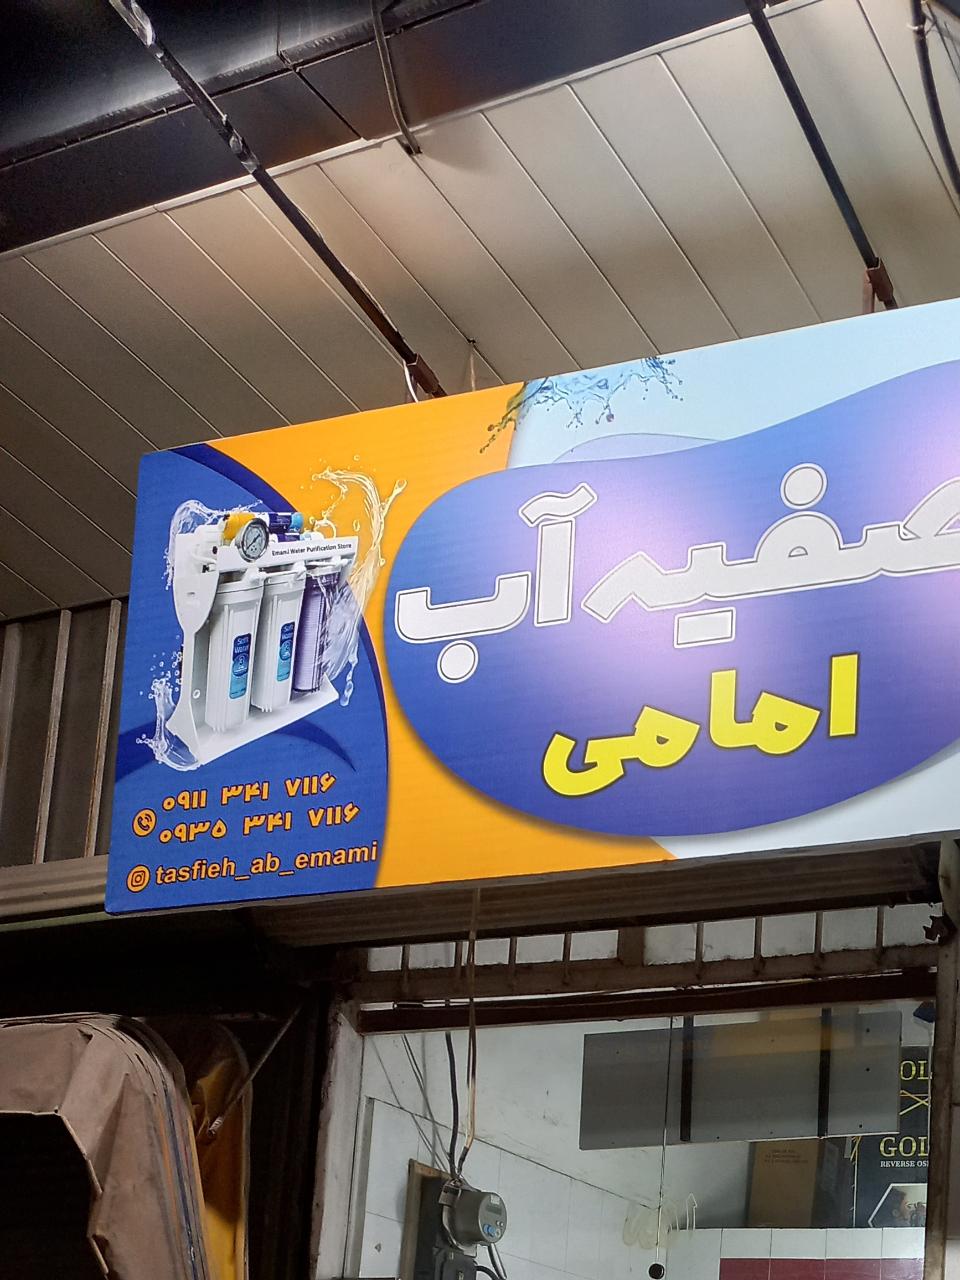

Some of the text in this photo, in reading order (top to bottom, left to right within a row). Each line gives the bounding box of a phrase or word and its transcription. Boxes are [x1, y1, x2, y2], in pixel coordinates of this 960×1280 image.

[394, 482, 599, 684] آب
[540, 652, 860, 796] امامی
[155, 840, 379, 885] tasfieh_ab_emami
[900, 1060, 933, 1081] OL
[879, 1136, 929, 1157] GOL
[880, 1160, 916, 1168] REVERSE
